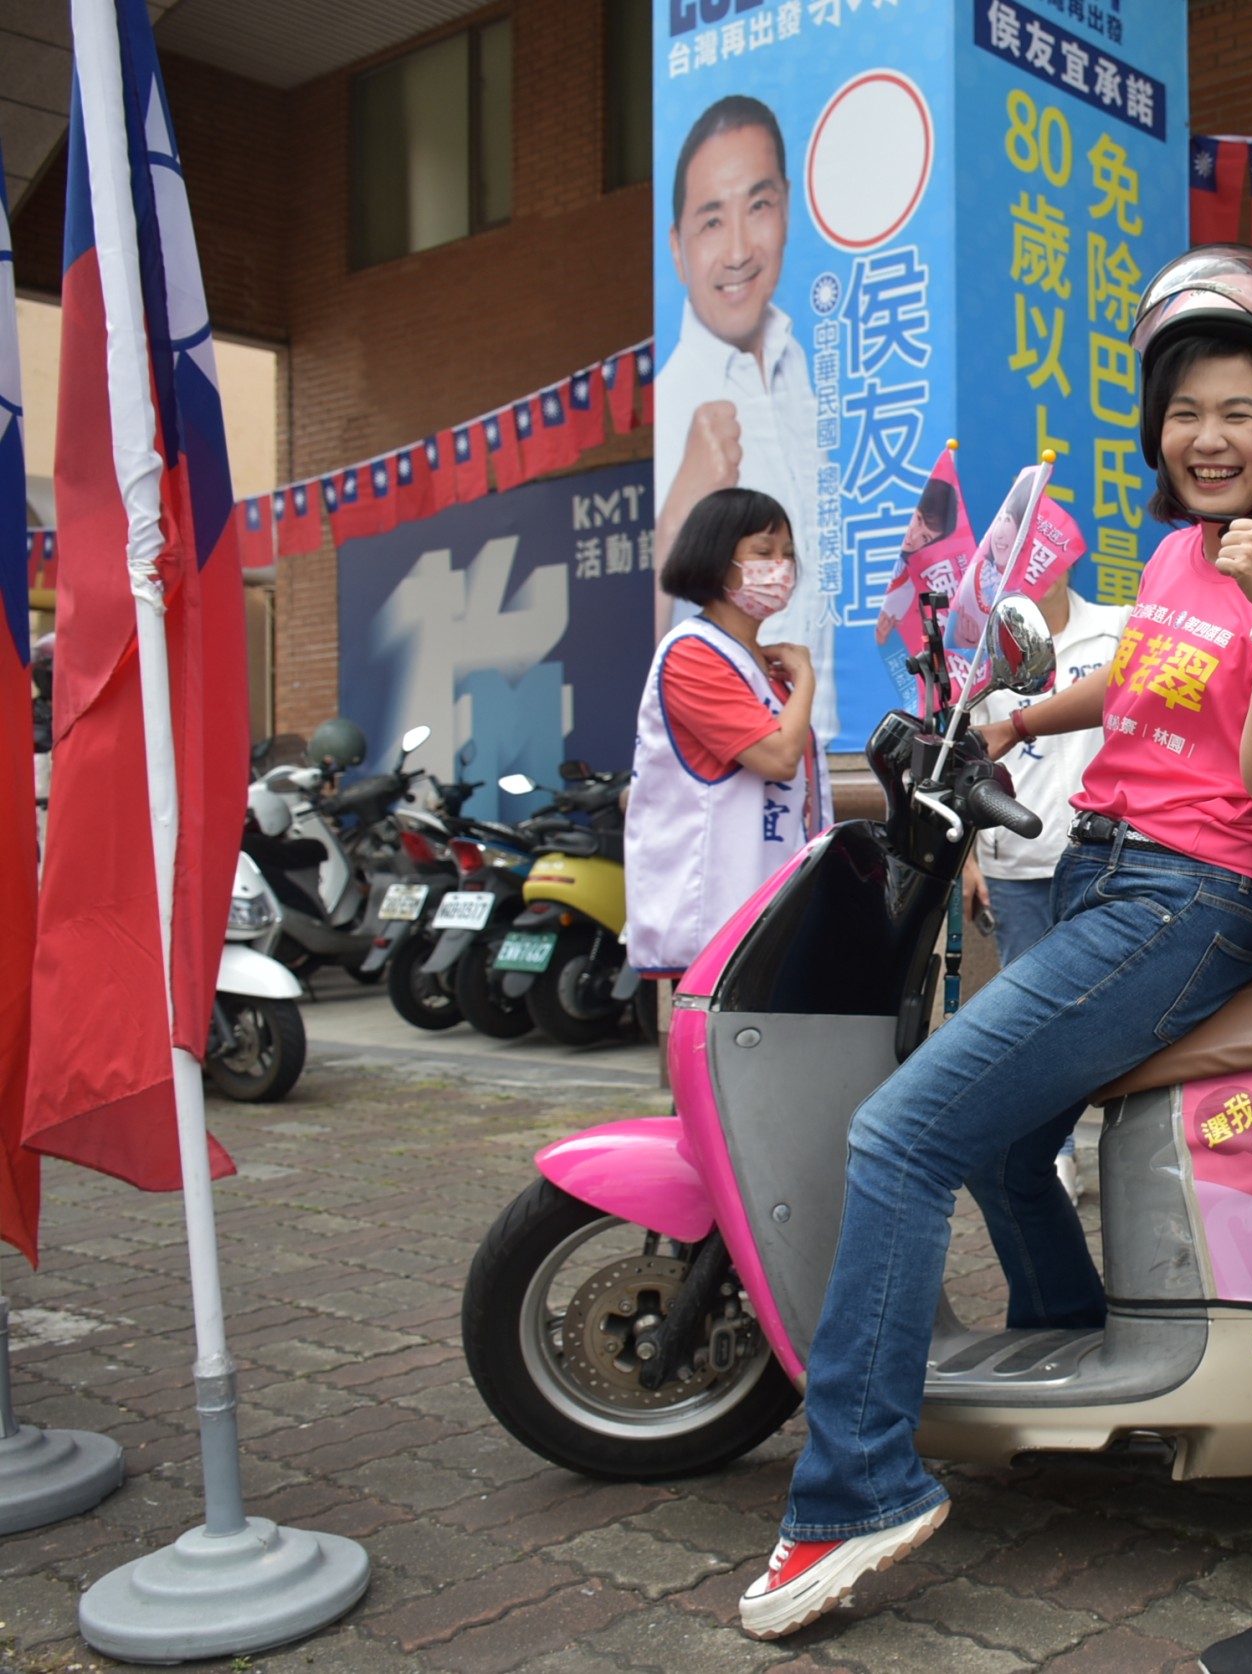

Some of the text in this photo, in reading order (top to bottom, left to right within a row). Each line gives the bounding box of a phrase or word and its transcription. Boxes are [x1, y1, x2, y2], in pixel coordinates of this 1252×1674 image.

[668, 2, 801, 79] 台灣再出發
[987, 0, 1155, 128] 侯友宜承諾
[1004, 89, 1074, 503] 80歲以上
[814, 319, 840, 450] 中華民國
[839, 244, 932, 627] 侯友宜
[572, 484, 645, 531] KMT
[1182, 616, 1235, 648] 第四選區
[1153, 727, 1186, 755] 林園
